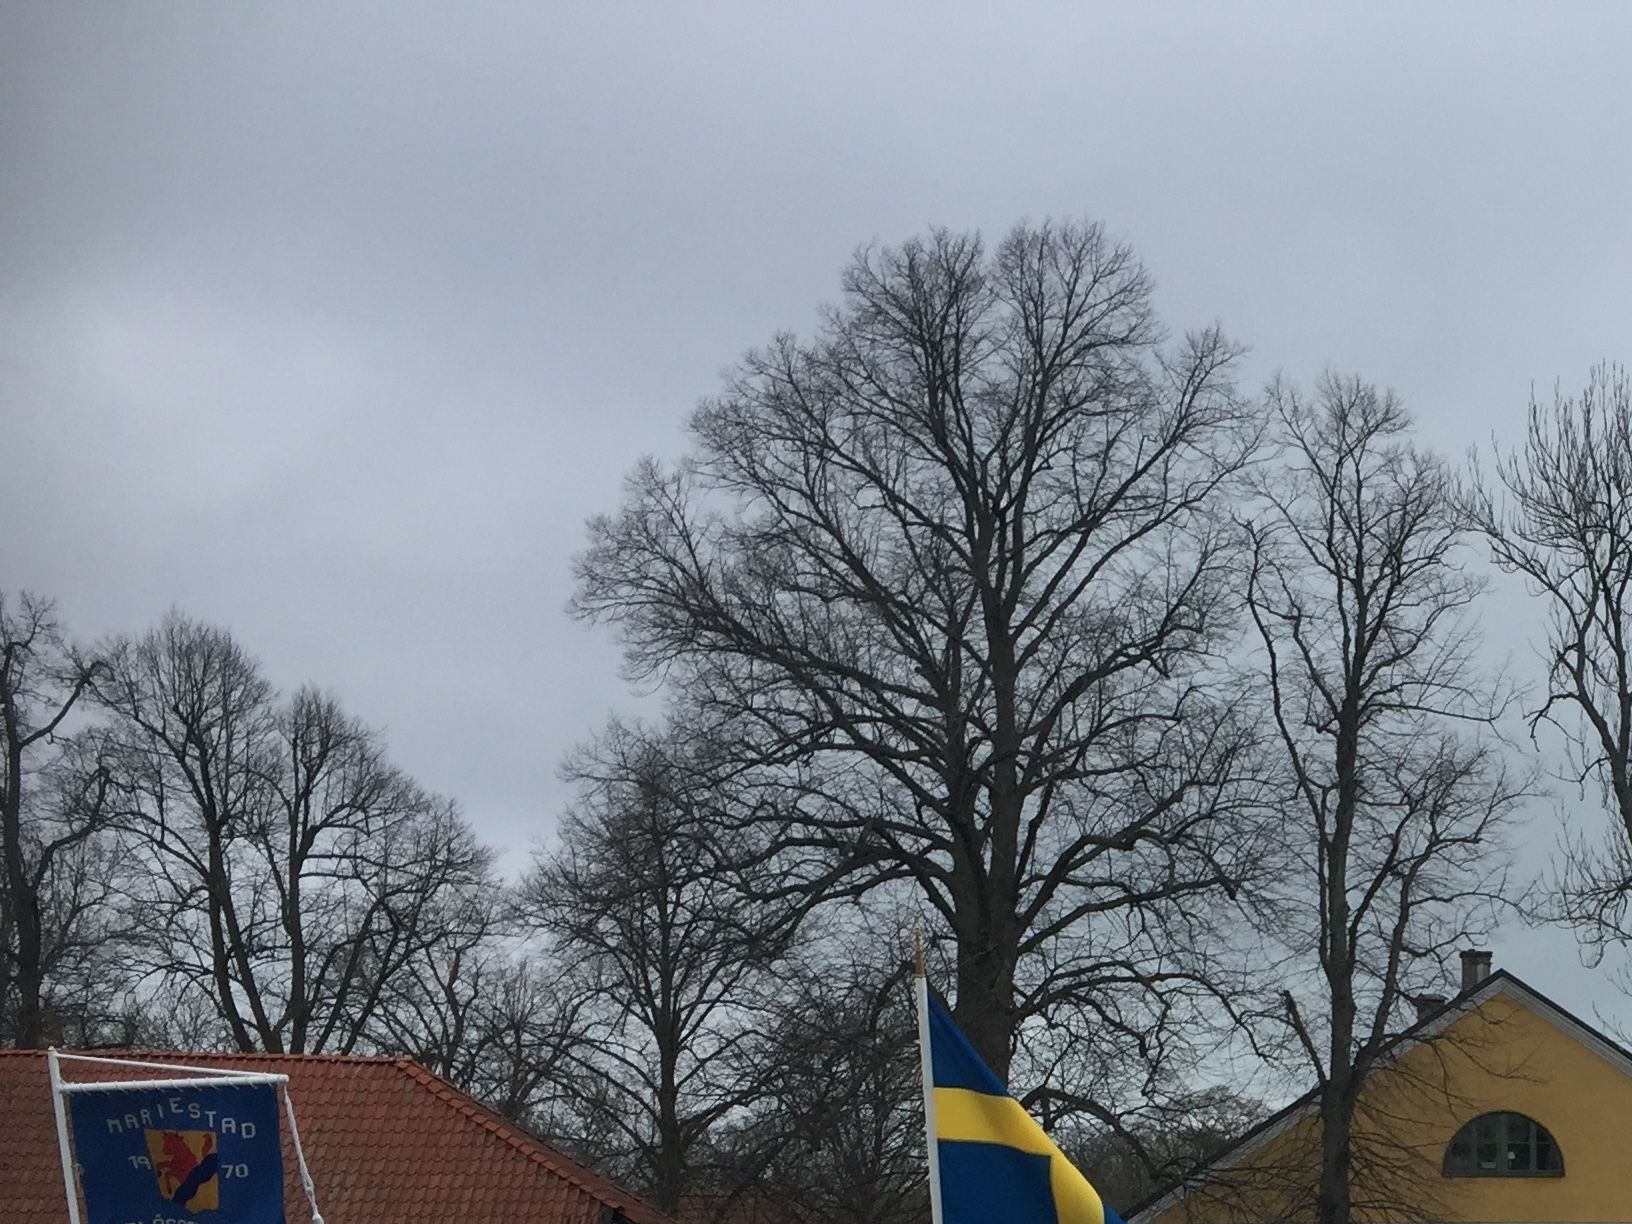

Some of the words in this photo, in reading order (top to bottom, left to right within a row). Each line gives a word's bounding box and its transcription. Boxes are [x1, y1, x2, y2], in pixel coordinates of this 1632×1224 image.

[106, 1097, 256, 1139] MARIESTAD
[128, 1155, 151, 1170] 19
[221, 1164, 249, 1179] 70
